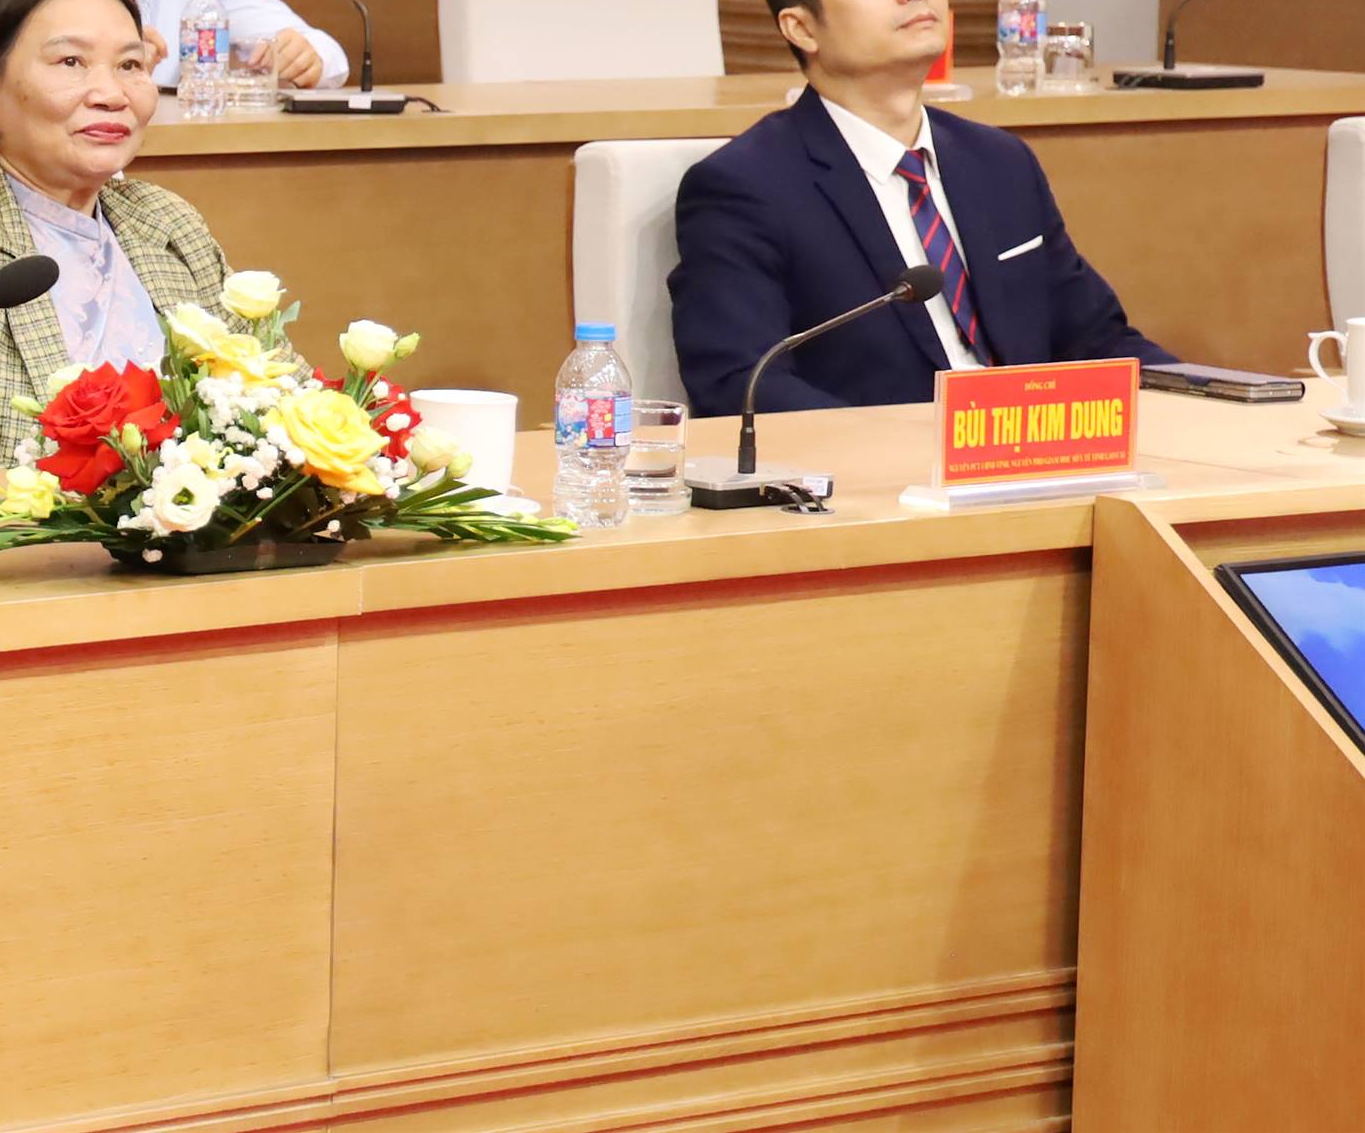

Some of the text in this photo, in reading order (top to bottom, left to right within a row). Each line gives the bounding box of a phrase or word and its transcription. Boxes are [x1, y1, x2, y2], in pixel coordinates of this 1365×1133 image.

[953, 399, 1123, 452] BÙI THỊ KIM DUNG
